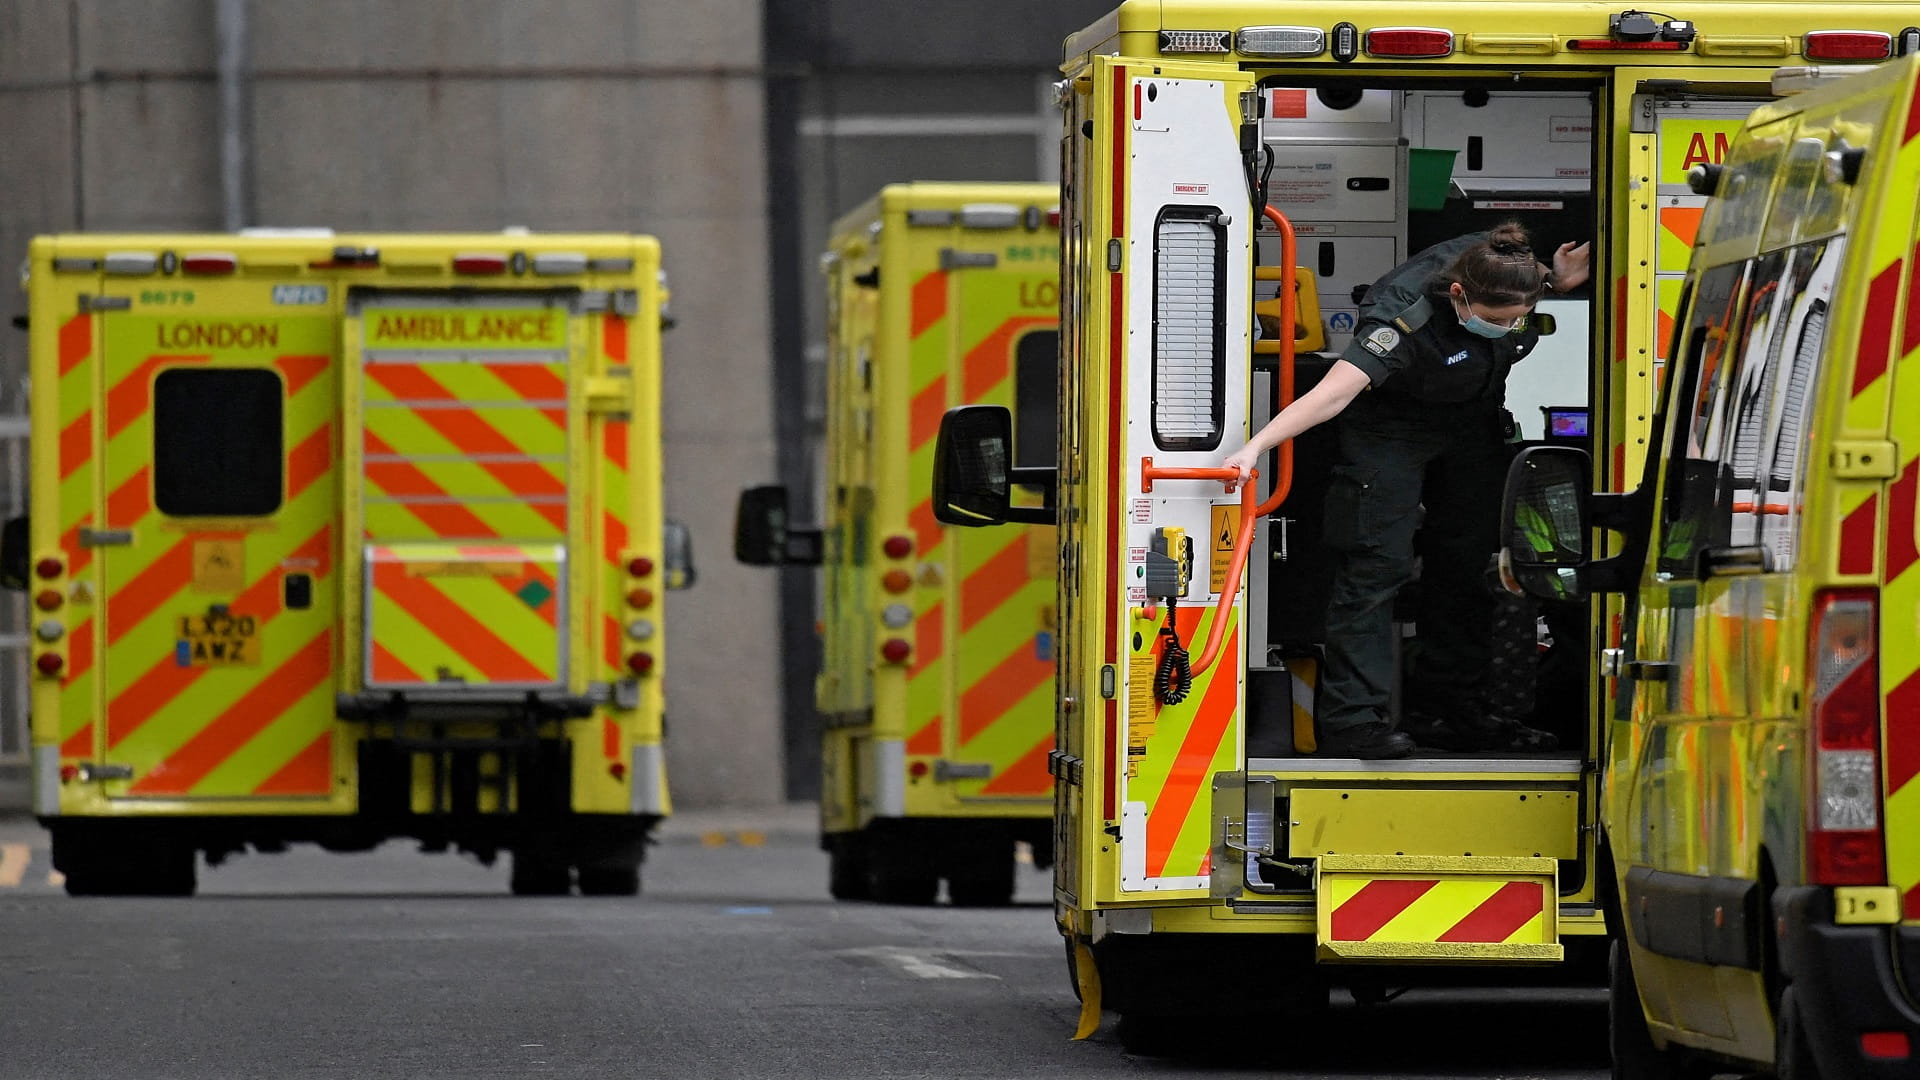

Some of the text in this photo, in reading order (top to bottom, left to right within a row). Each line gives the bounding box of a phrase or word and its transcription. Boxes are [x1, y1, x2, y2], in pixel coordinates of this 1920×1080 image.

[157, 322, 279, 348] LONDON
[377, 314, 555, 342] AMBULANCE
[1447, 350, 1467, 365] NHS
[182, 616, 255, 637] LX20
[194, 640, 245, 662] AWZ
